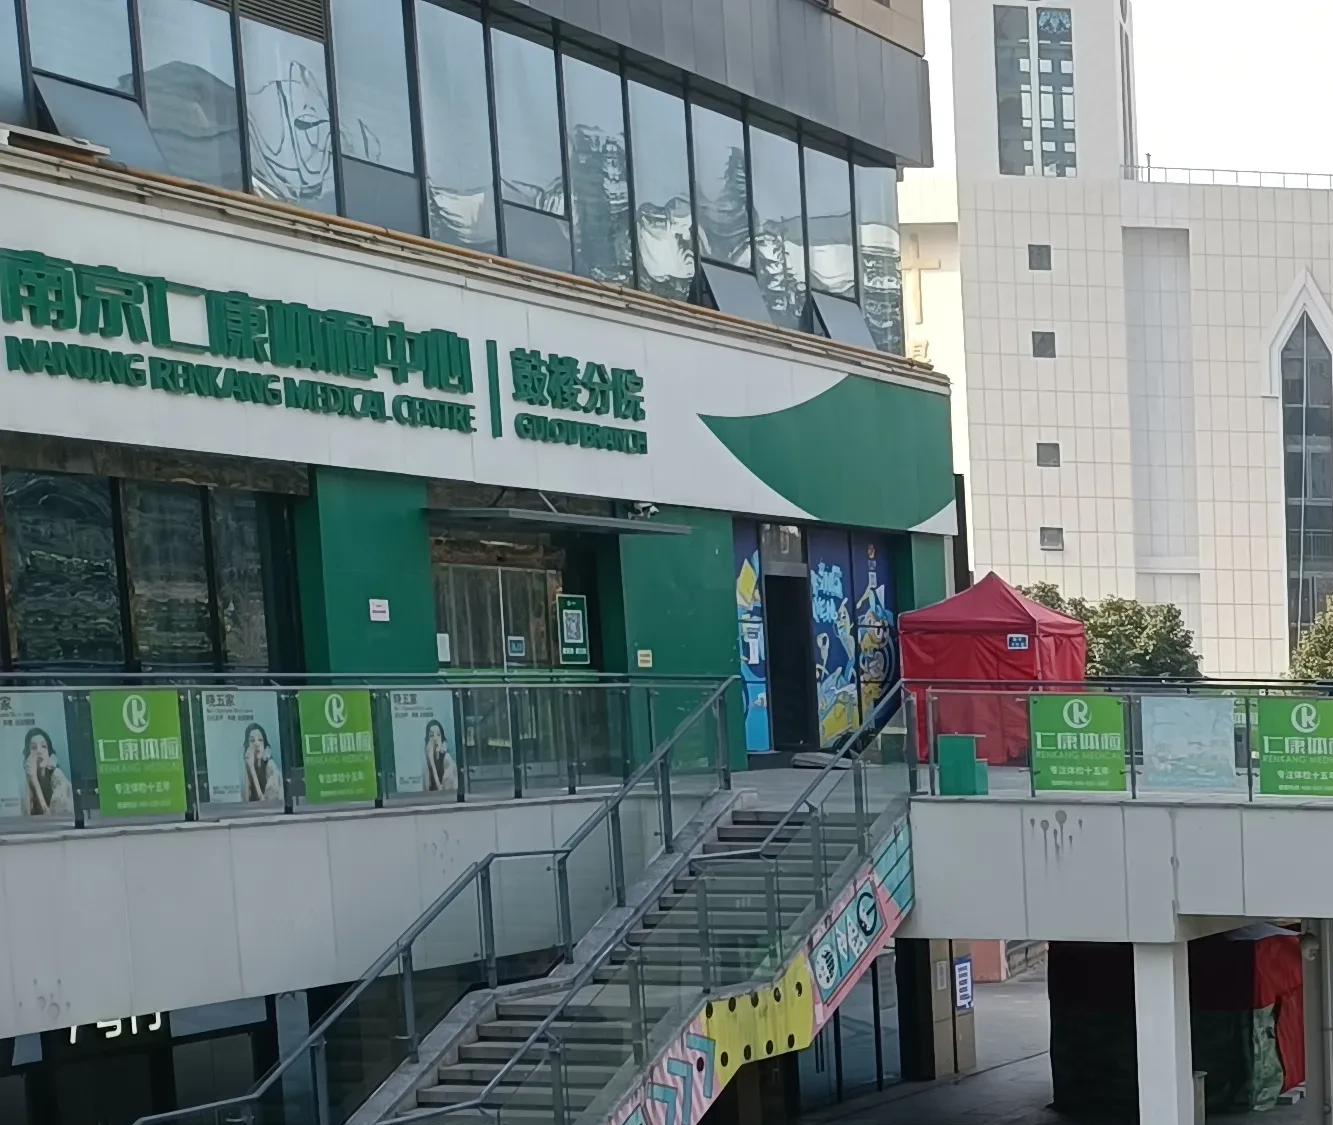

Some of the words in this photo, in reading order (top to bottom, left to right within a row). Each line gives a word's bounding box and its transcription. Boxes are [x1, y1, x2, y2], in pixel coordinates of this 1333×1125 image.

[0, 247, 474, 393] 南京仁康体检中心
[4, 335, 147, 386] NANJING
[148, 356, 282, 405] RENKANG
[284, 377, 392, 422] MEDICAL
[392, 394, 477, 432] CENTRE
[510, 348, 645, 421] 鼓楼分院
[579, 422, 648, 454] BRANCH
